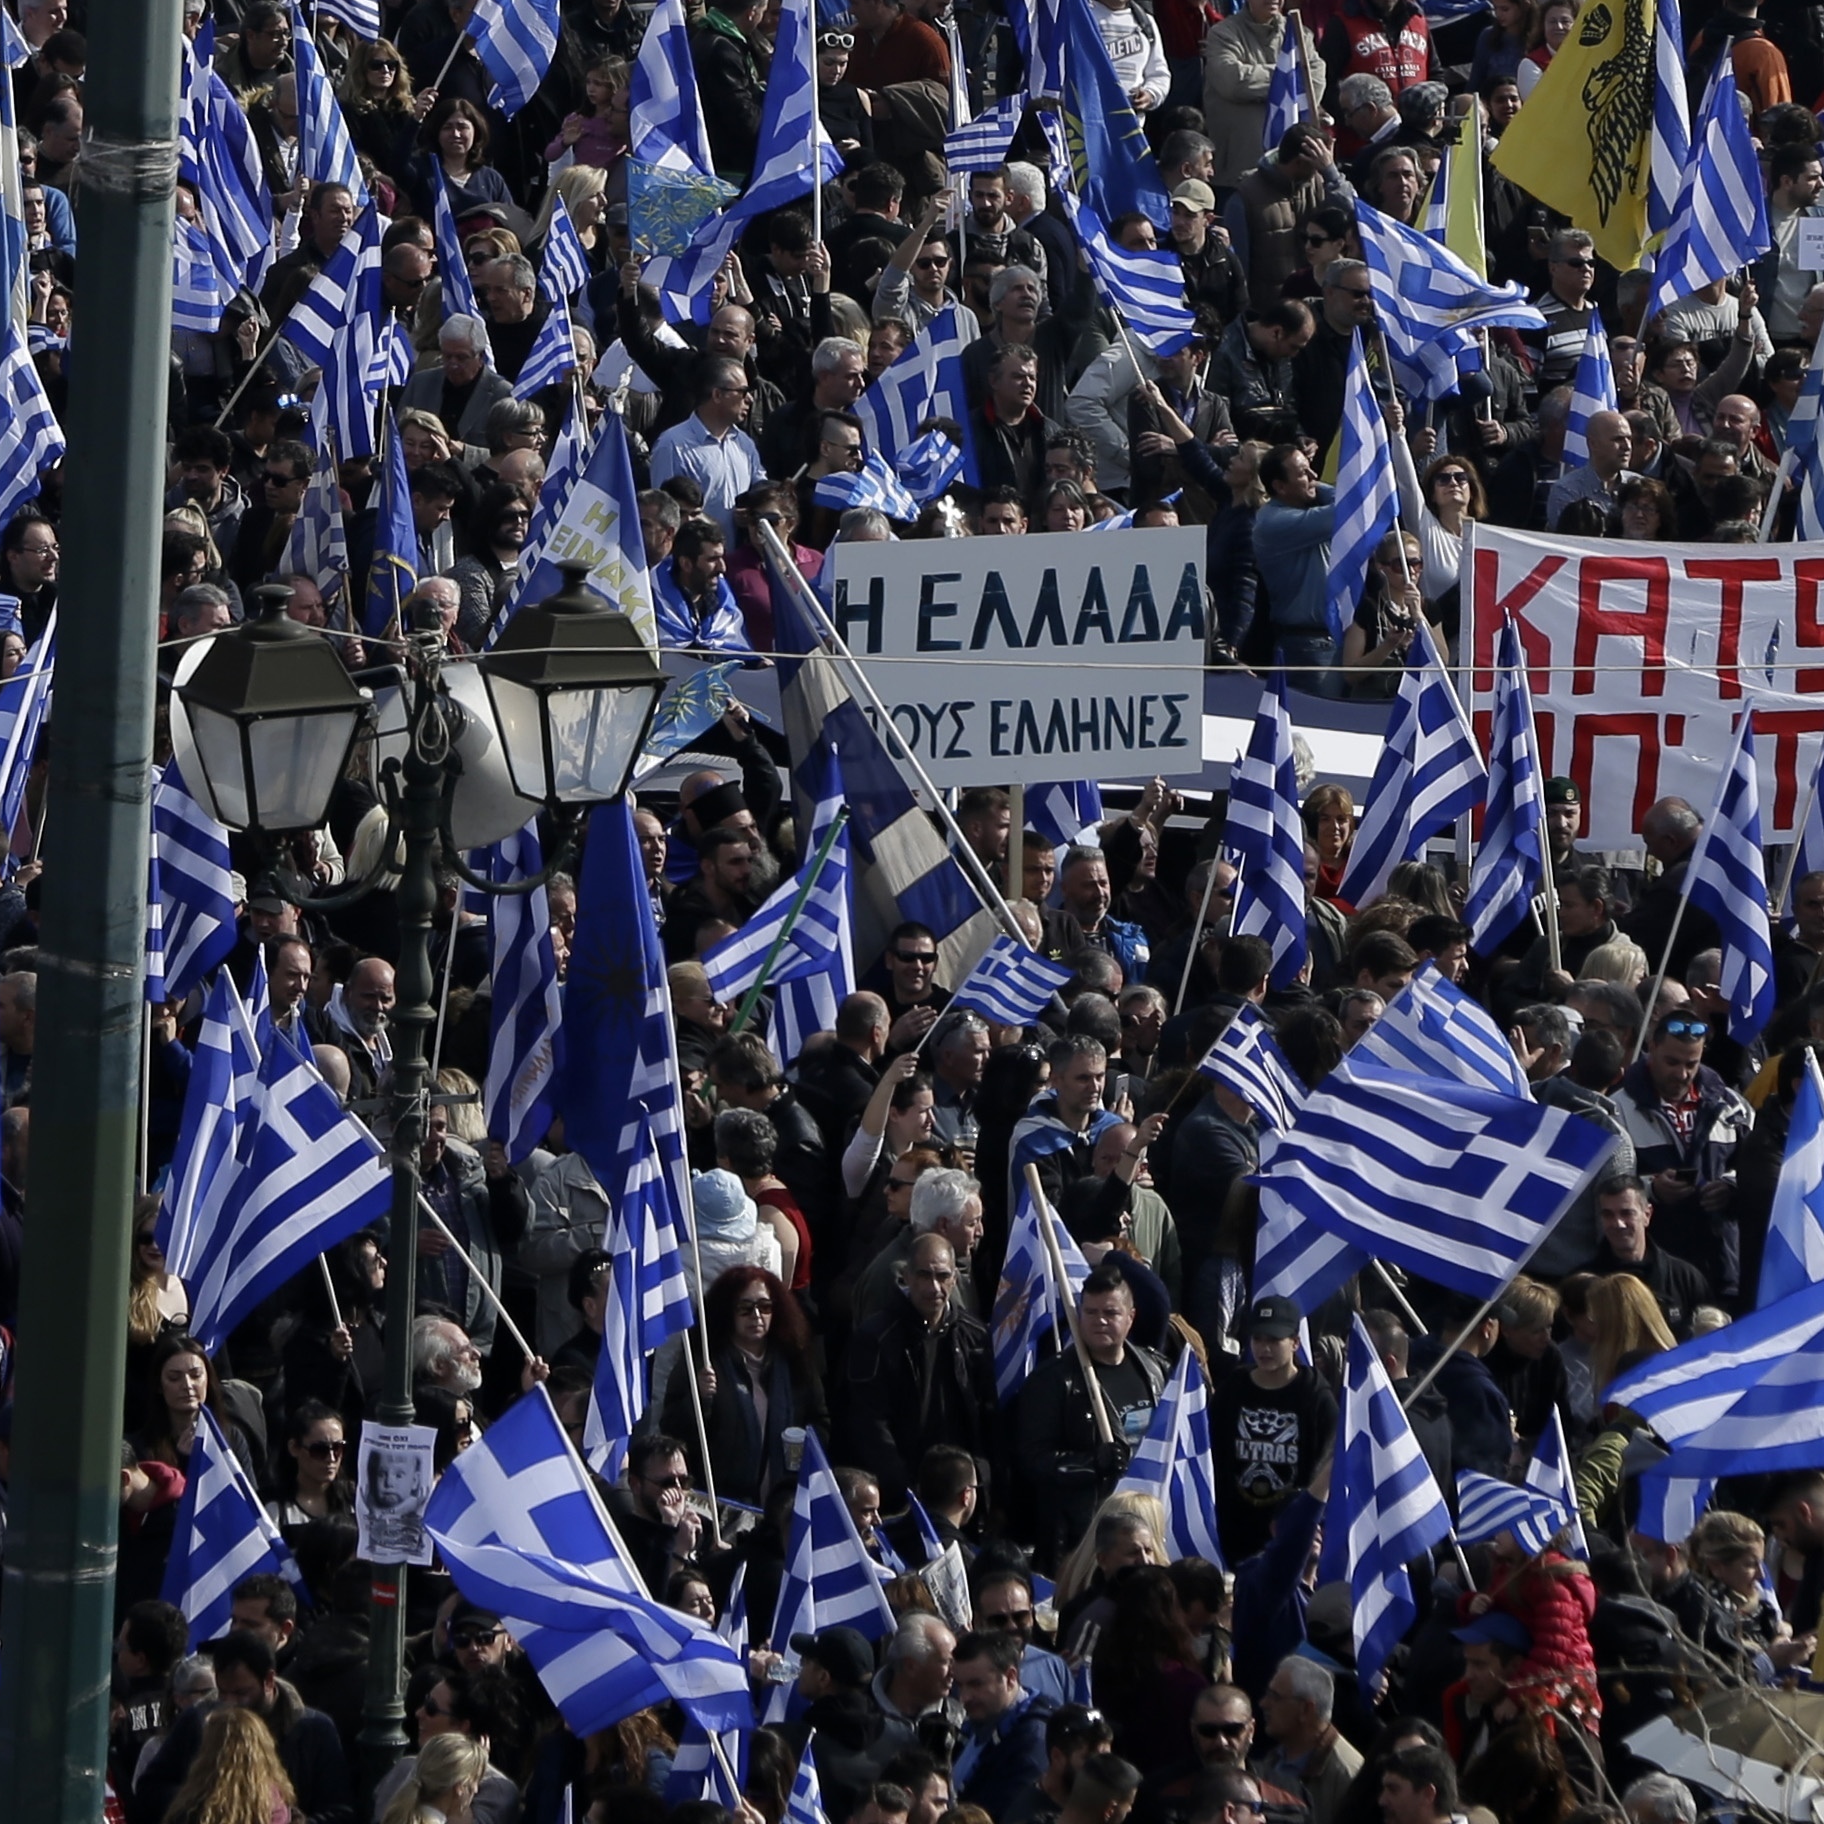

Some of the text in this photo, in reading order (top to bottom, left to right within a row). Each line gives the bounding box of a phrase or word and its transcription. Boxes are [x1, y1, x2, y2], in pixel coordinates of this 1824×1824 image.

[835, 562, 1205, 654] Η ΕΛΛΑΔΑ
[989, 692, 1190, 757] ΕΛΛΗΝΕΣ
